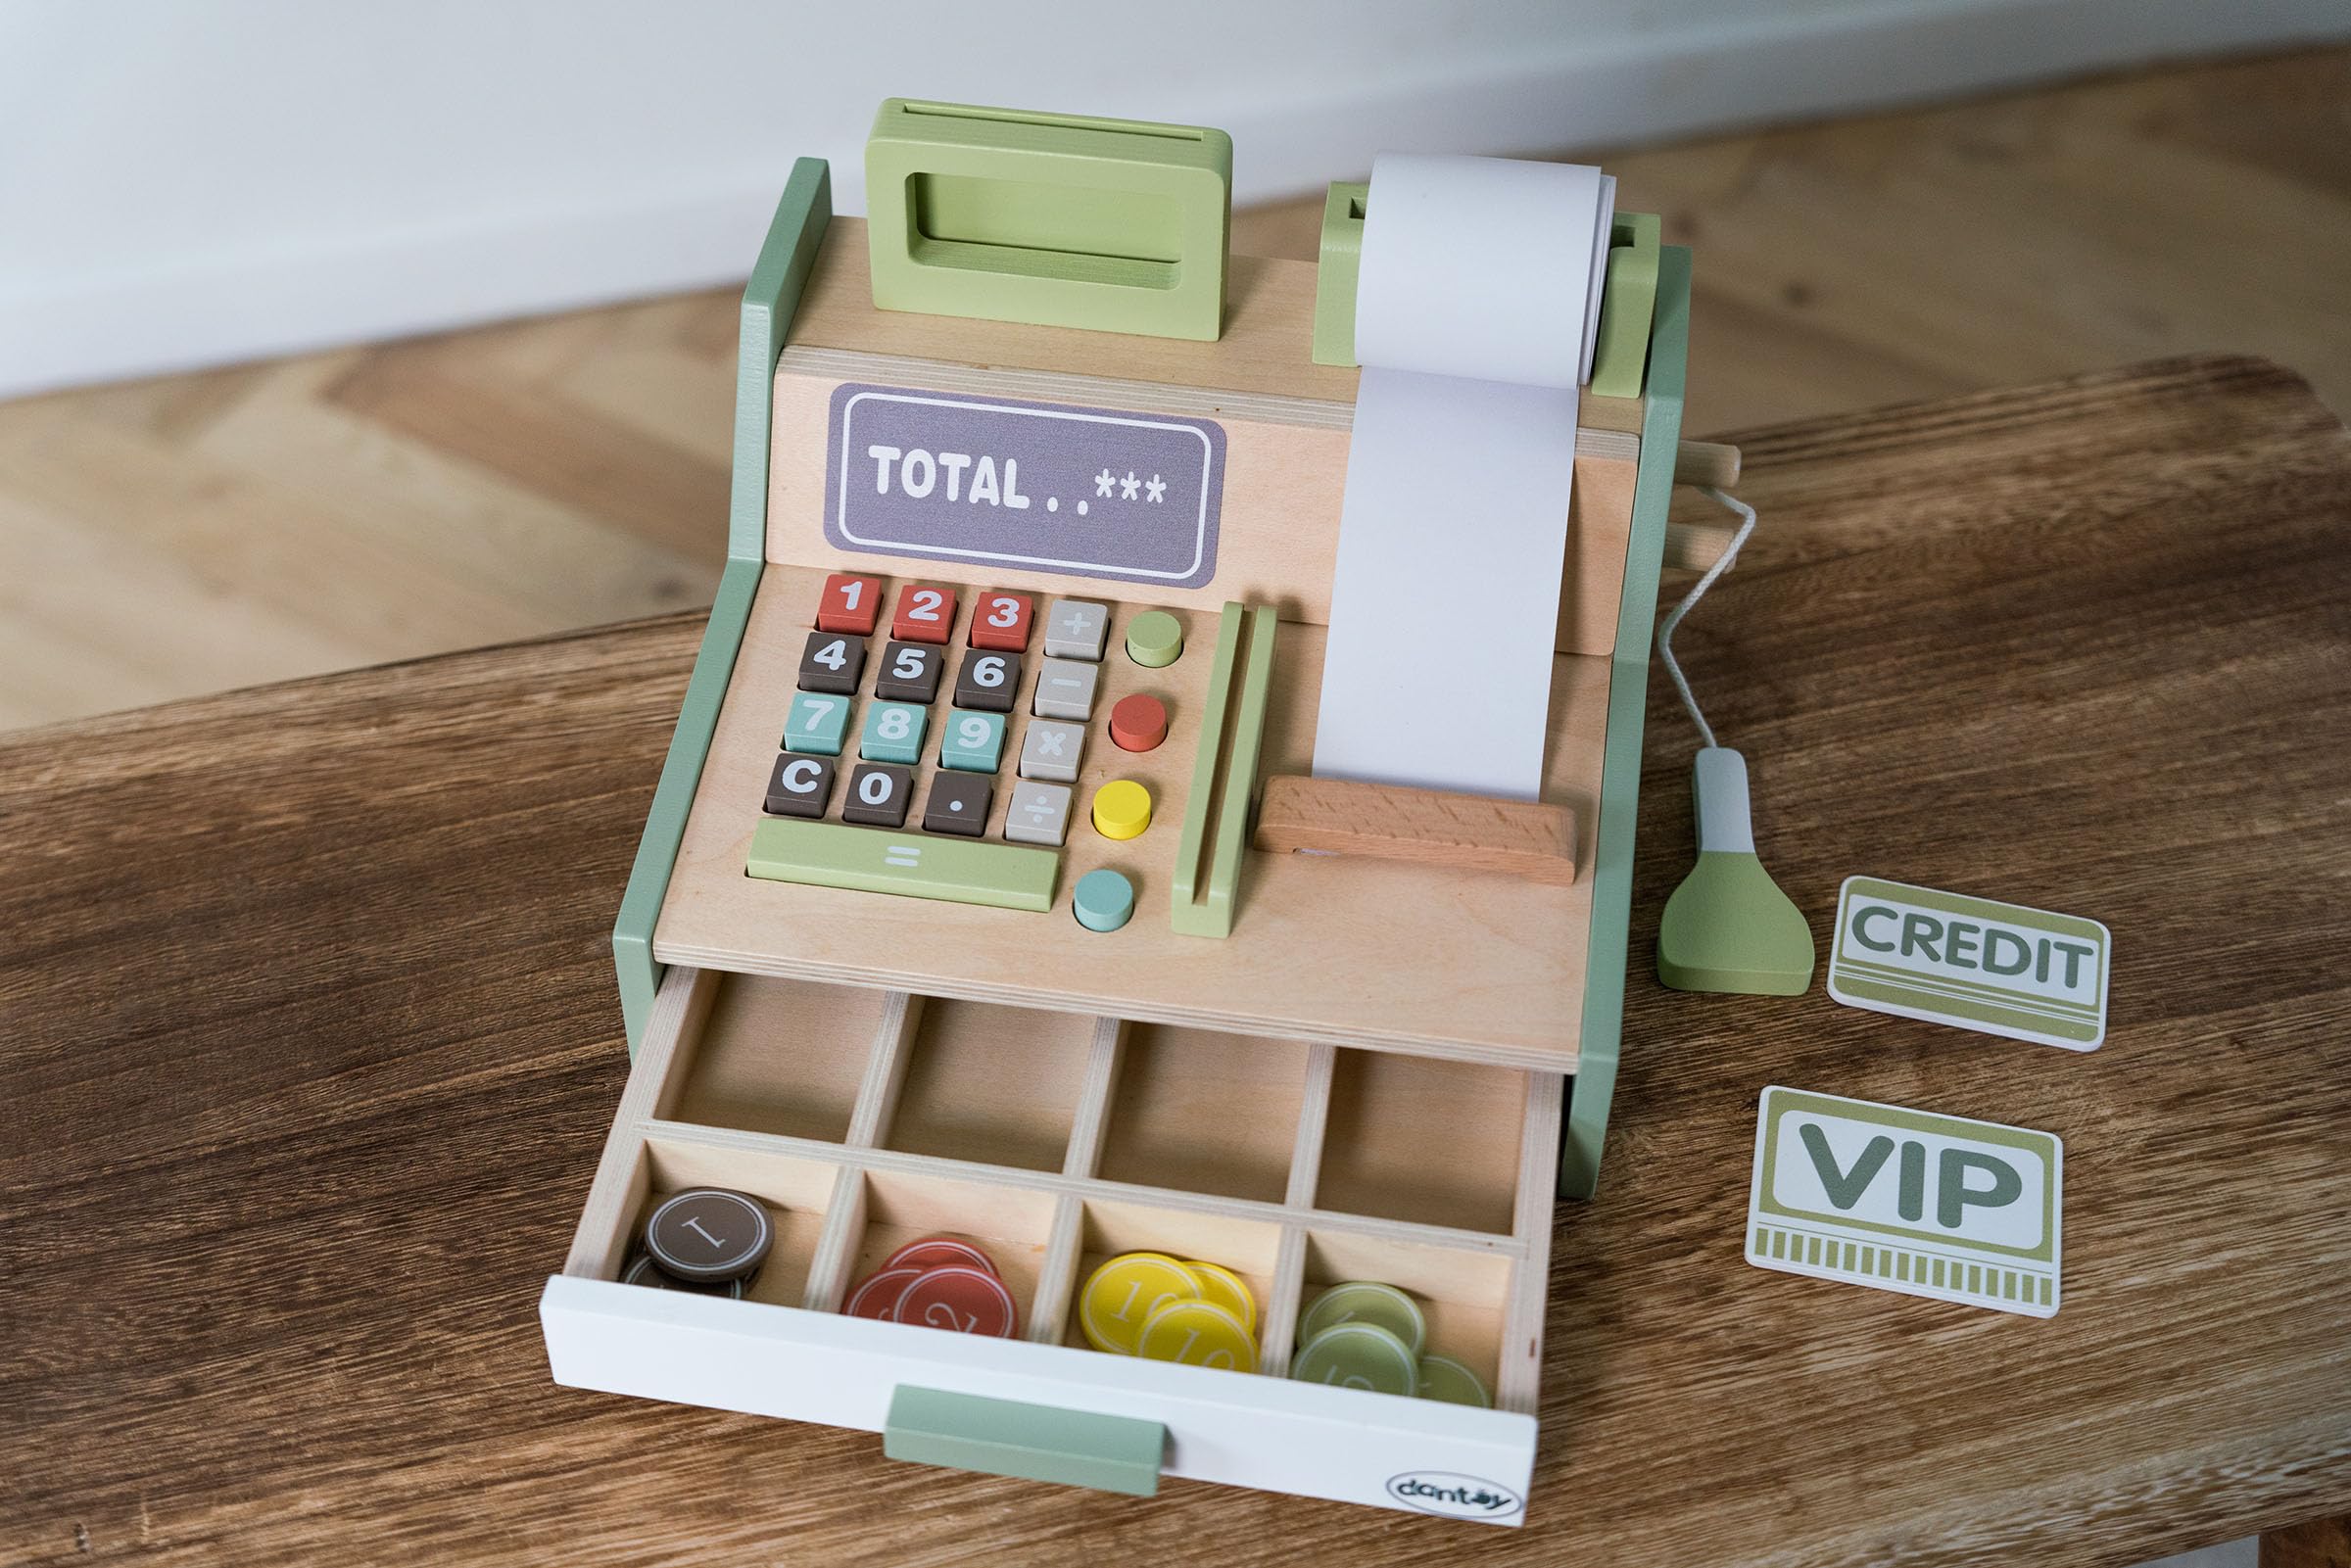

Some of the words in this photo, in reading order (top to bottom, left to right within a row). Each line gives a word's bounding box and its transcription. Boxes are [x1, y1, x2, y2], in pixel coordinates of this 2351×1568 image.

[868, 445, 1031, 509] TOTAL
[840, 581, 863, 610] 1
[908, 591, 943, 622] 2
[987, 597, 1020, 628] 3
[813, 640, 847, 671] 4
[892, 648, 926, 680] 5
[972, 656, 1006, 688] 6
[802, 699, 835, 731] 7
[877, 708, 911, 739] 8
[958, 717, 991, 748] 9
[782, 759, 822, 793] C
[858, 772, 892, 805] 0
[1851, 905, 2094, 989] CREDIT
[1799, 1122, 2023, 1228] VIP
[681, 1215, 726, 1249] 1
[1397, 1479, 1512, 1510] dantoy
